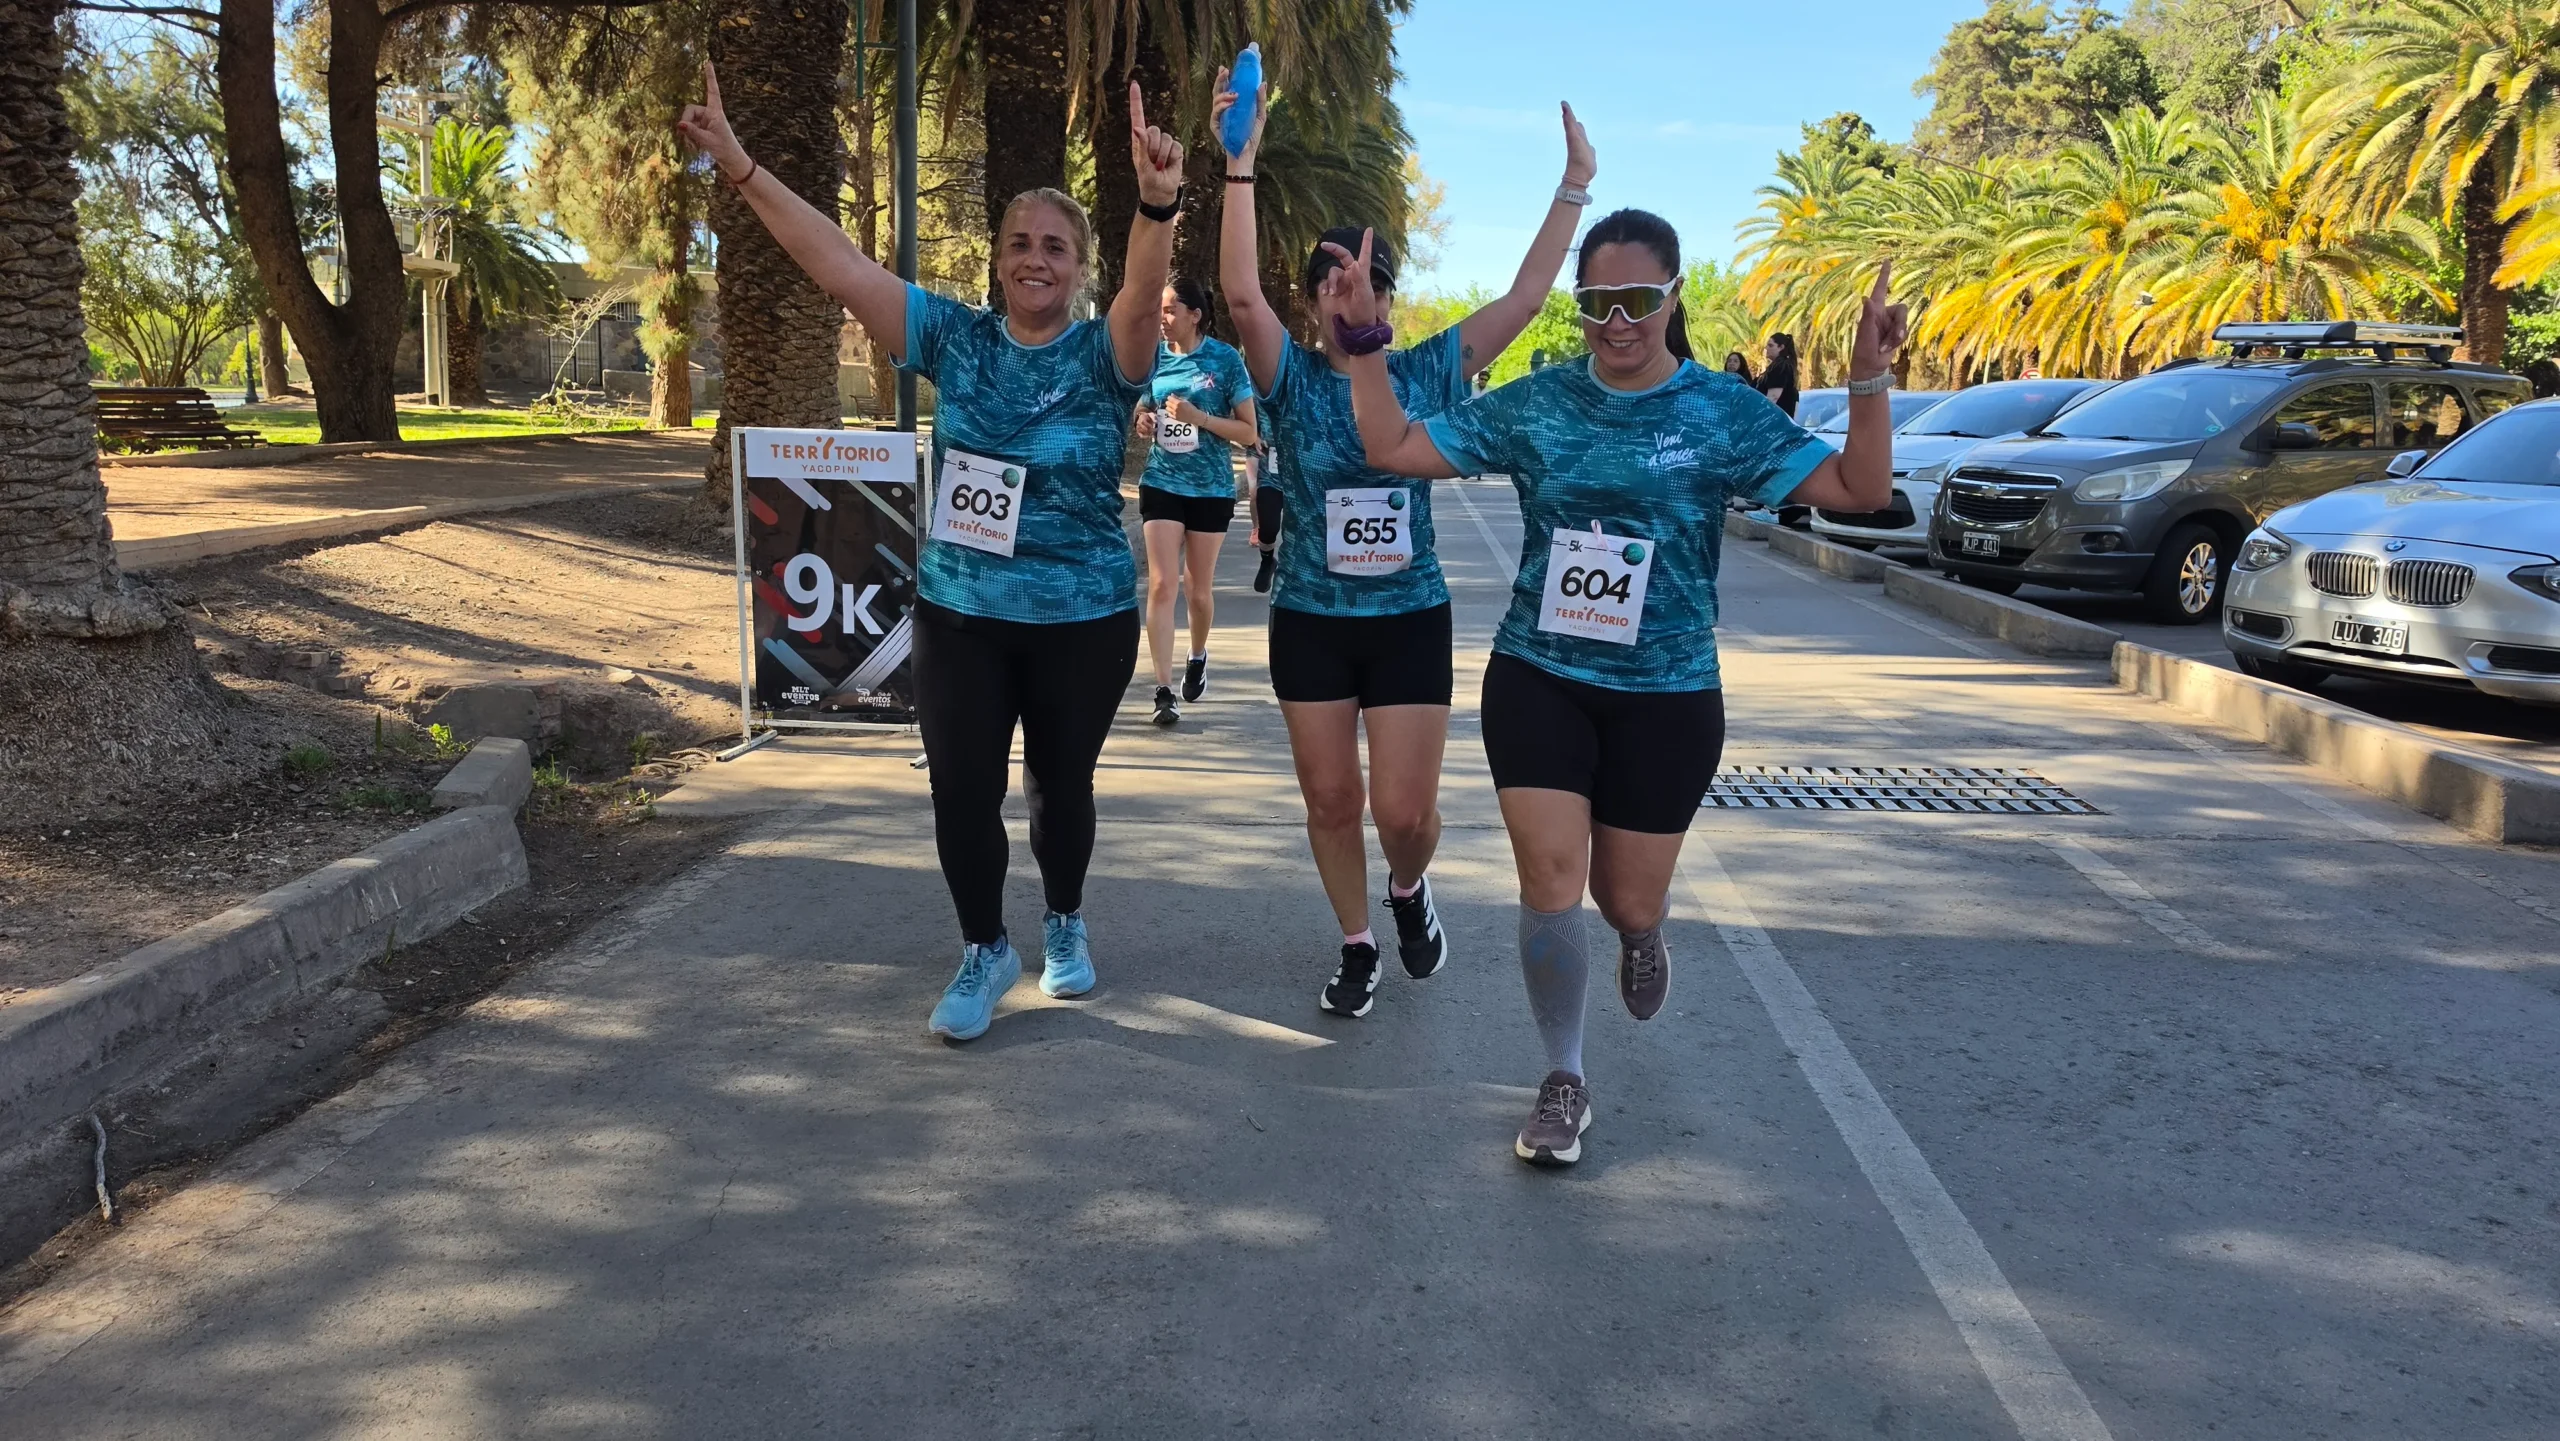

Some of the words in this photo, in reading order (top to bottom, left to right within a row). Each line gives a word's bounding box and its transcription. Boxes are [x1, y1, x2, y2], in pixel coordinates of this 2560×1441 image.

[1163, 423, 1192, 437] 566
[801, 464, 859, 474] YACOPINI
[957, 460, 970, 473] 5k
[951, 483, 1011, 521] 603
[1341, 496, 1354, 507] 5k
[1343, 517, 1397, 545] 655
[1569, 539, 1583, 553] 5k
[1982, 539, 1998, 553] 441
[1560, 565, 1632, 604] 604
[2333, 621, 2364, 643] LUX
[2371, 626, 2404, 648] 348
